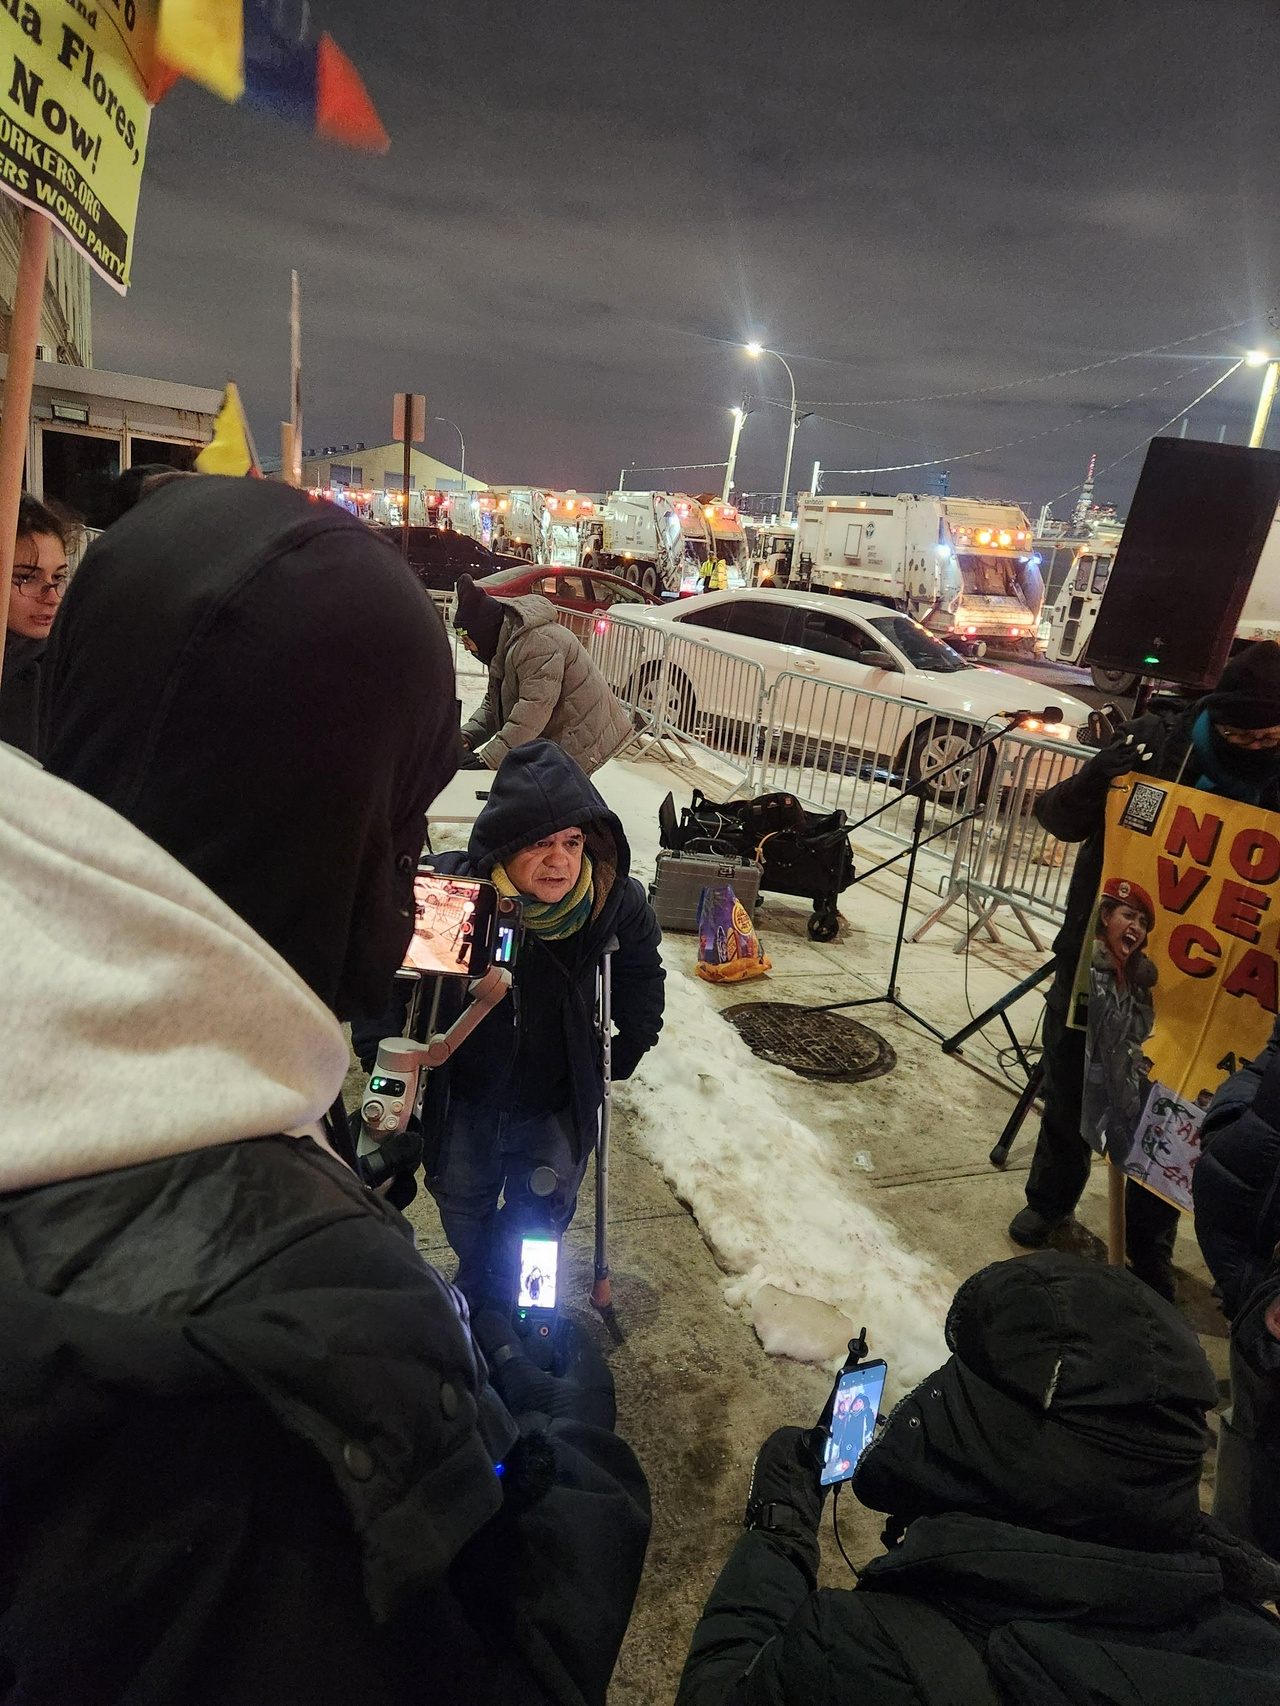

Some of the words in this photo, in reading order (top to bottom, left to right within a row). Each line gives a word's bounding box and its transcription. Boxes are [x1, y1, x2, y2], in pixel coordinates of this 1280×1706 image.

[8, 53, 102, 175] Now!
[57, 22, 139, 165] Flores,
[36, 178, 87, 240] WORLD
[1164, 805, 1280, 887] NO
